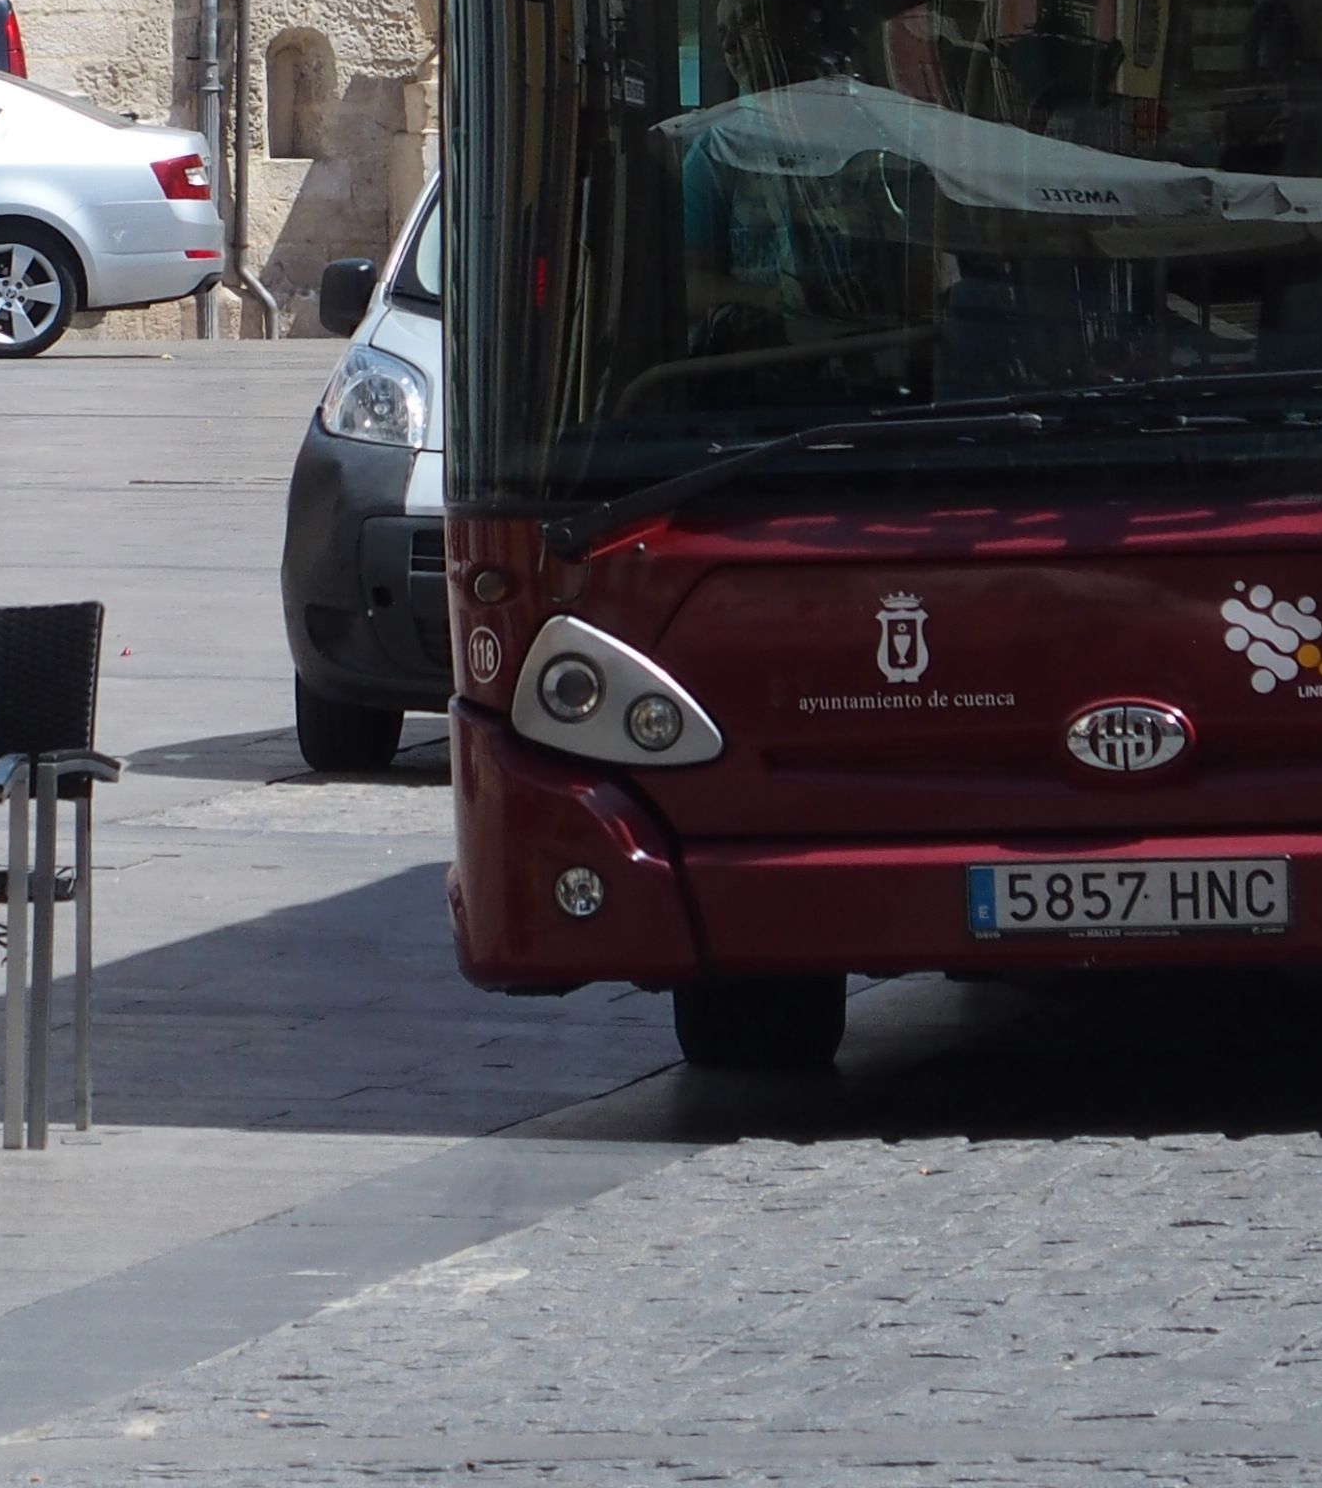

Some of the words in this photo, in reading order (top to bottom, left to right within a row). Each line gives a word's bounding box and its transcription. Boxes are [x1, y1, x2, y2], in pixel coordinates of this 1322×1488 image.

[472, 639, 495, 671] 118
[798, 691, 922, 714] ayuntamiento
[927, 690, 949, 708] de
[953, 691, 1016, 708] cuenca
[1009, 871, 1146, 921] 5857
[1170, 869, 1276, 920] HNC
[978, 905, 990, 919] E
